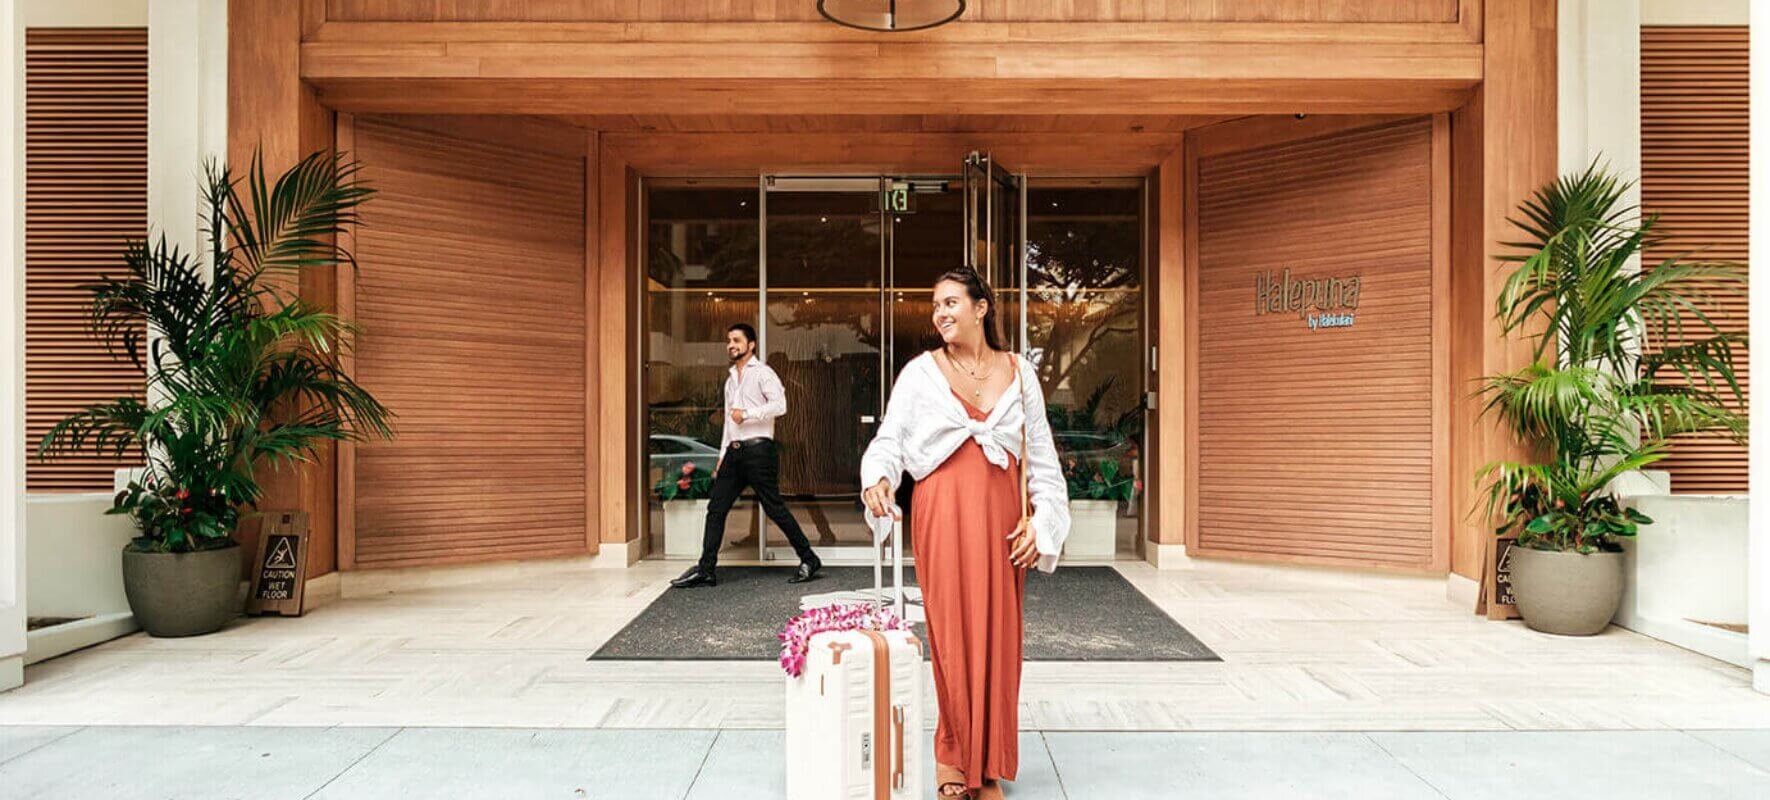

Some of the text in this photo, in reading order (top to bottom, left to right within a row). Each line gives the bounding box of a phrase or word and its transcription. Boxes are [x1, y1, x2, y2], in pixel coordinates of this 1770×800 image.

[1256, 267, 1360, 319] Halepuna
[1308, 314, 1318, 331] by
[263, 570, 295, 579] CAUTION
[268, 581, 286, 590] WET
[262, 591, 288, 599] FLOOR
